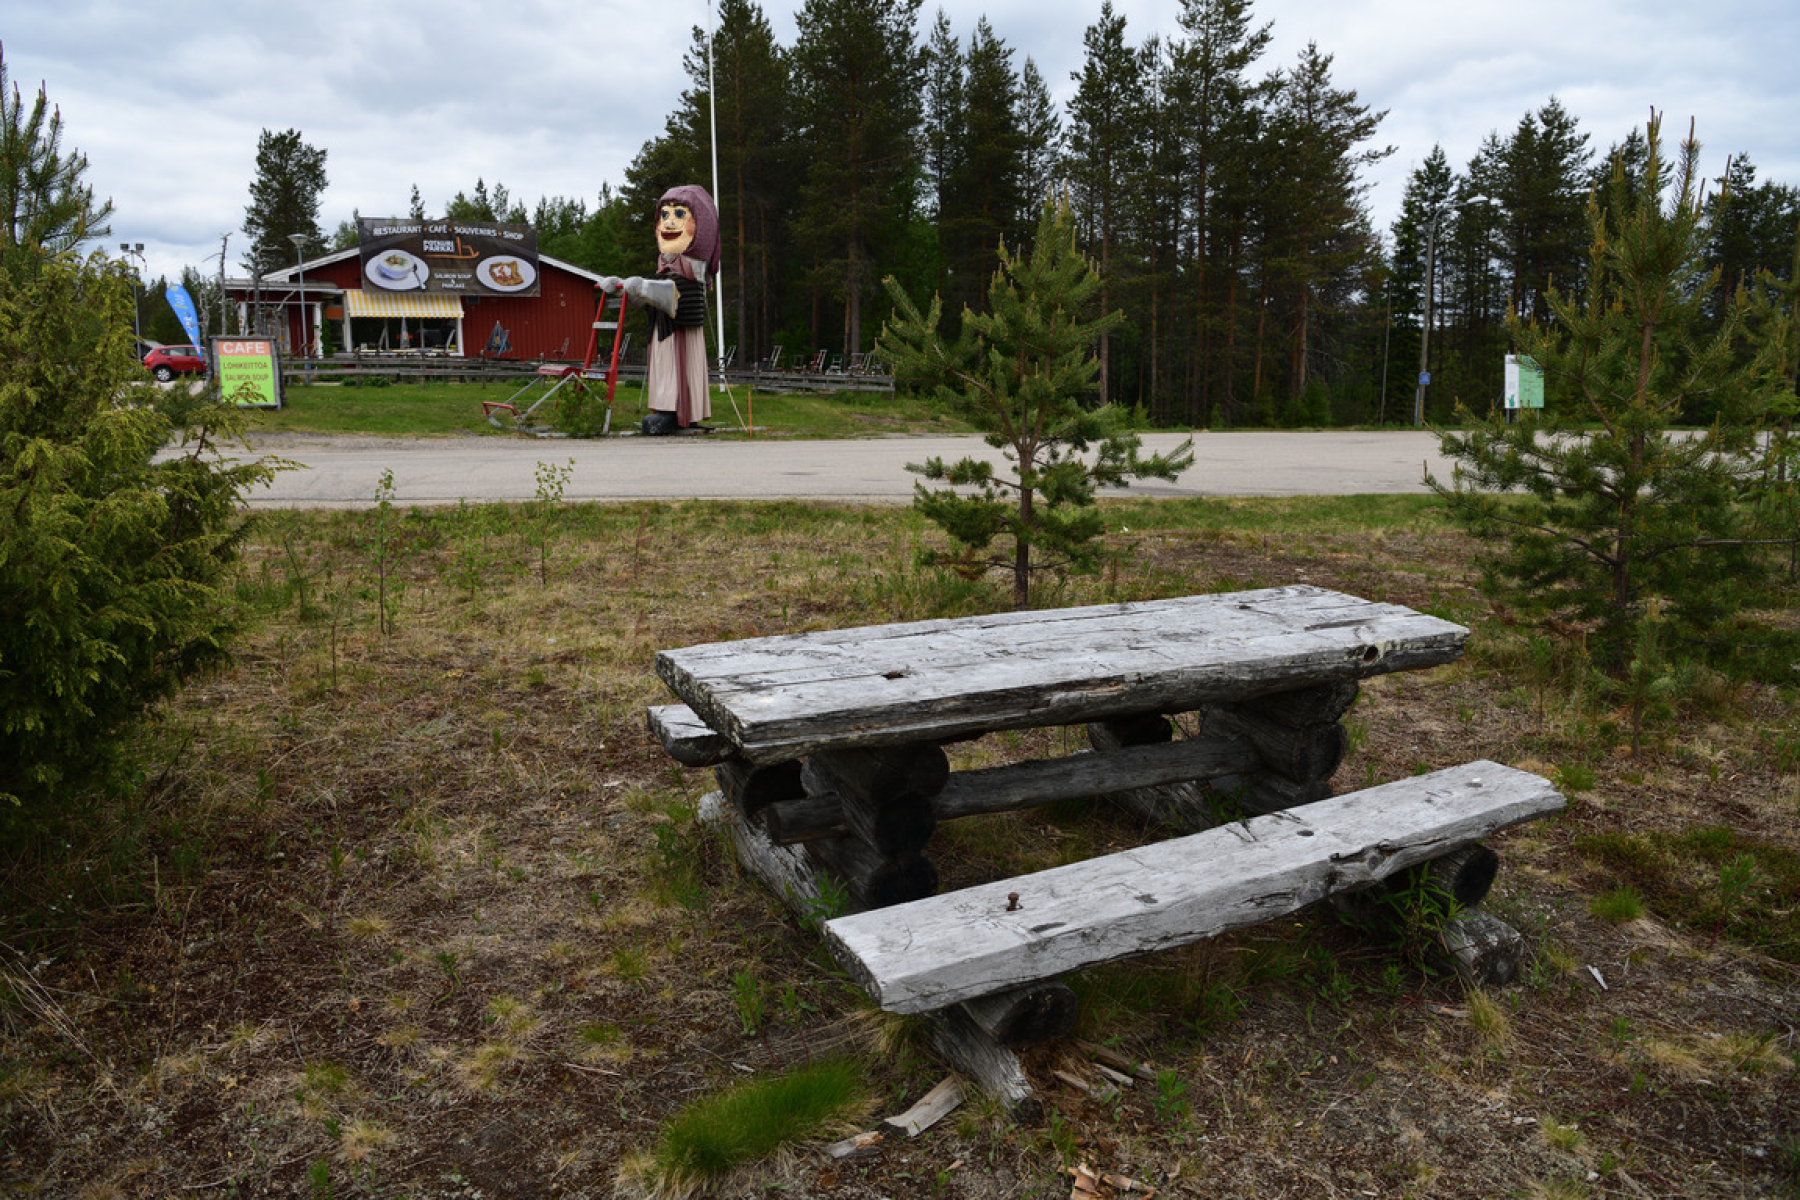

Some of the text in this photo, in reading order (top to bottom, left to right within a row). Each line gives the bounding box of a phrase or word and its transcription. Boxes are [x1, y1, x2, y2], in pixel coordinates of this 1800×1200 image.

[373, 225, 422, 236] RESTAURANT
[454, 226, 497, 236] SOUVENIRS
[223, 342, 265, 354] CAFE
